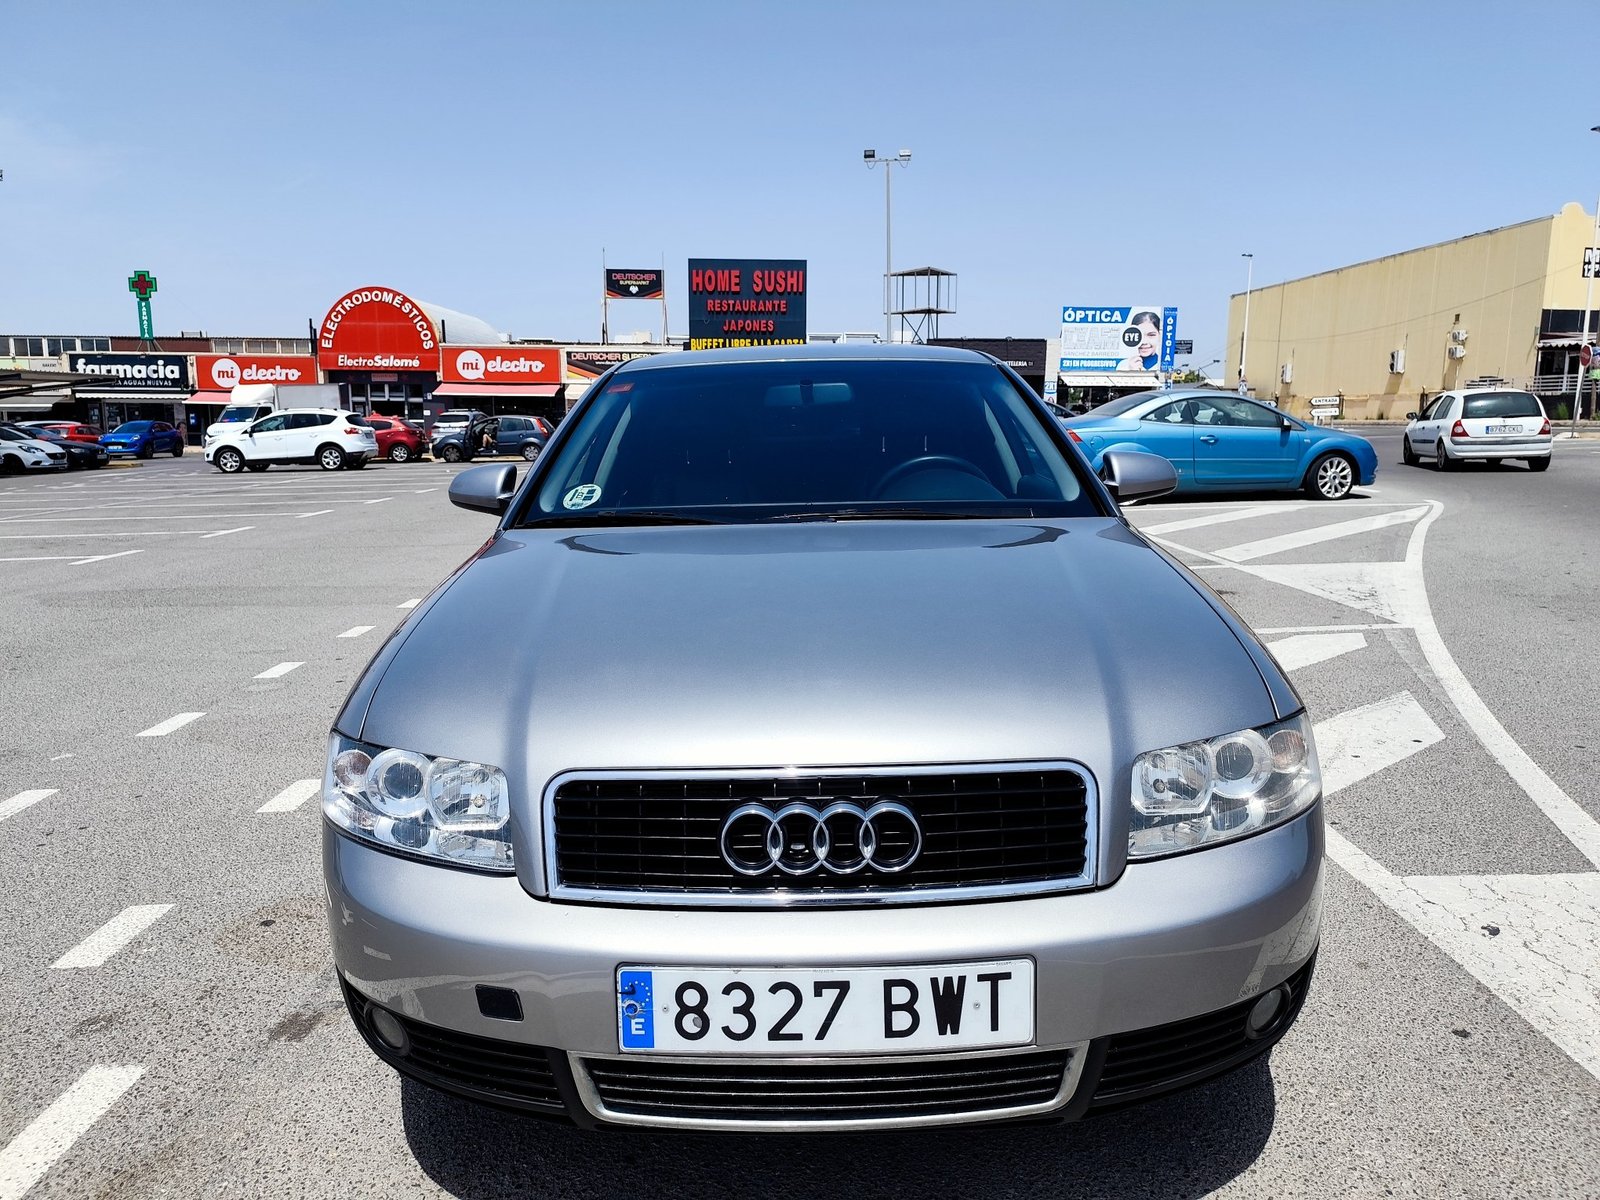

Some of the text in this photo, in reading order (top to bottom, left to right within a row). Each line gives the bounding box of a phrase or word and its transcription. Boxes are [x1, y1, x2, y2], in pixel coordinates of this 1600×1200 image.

[611, 273, 657, 281] DEUTSCHER
[692, 269, 804, 293] HOME SUSHI
[707, 299, 787, 312] RESTAURANTE
[321, 290, 434, 350] ELECTRODOMÉSTICOS
[1063, 310, 1122, 323] ÓPTICA
[723, 319, 775, 332] JAPONES
[1124, 332, 1139, 342] EYE
[76, 358, 180, 379] farmacia
[338, 355, 420, 368] ElectroSalomé
[462, 356, 545, 373] mi electro
[217, 364, 302, 381] mi electro
[674, 972, 1012, 1041] 8327 BWT
[631, 1018, 646, 1035] E
